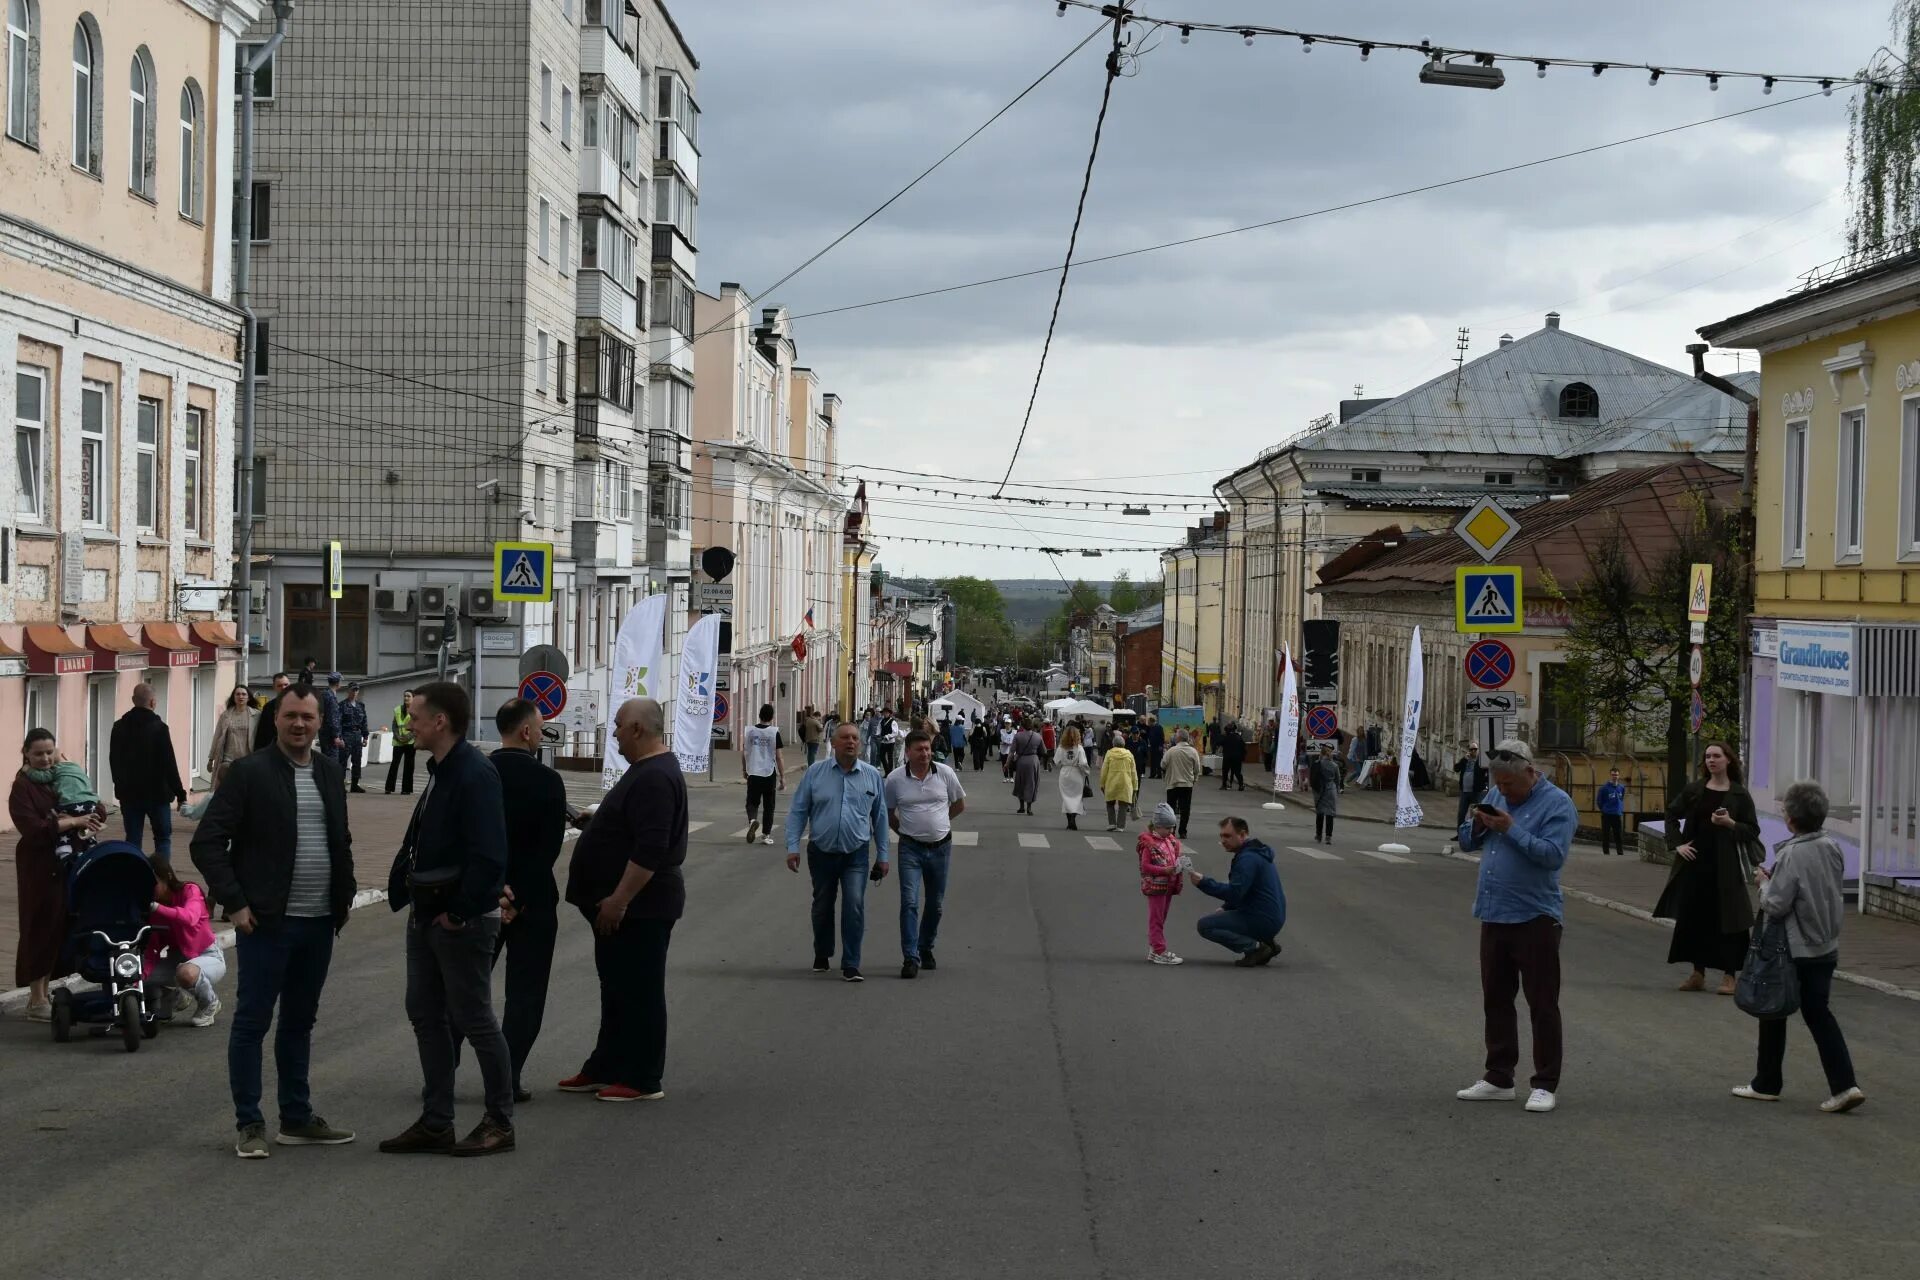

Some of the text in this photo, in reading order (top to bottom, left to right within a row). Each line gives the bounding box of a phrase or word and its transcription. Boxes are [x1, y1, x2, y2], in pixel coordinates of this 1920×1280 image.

[1780, 641, 1850, 671] GrandHouse
[1691, 657, 1700, 674] 40
[686, 706, 709, 715] 650
